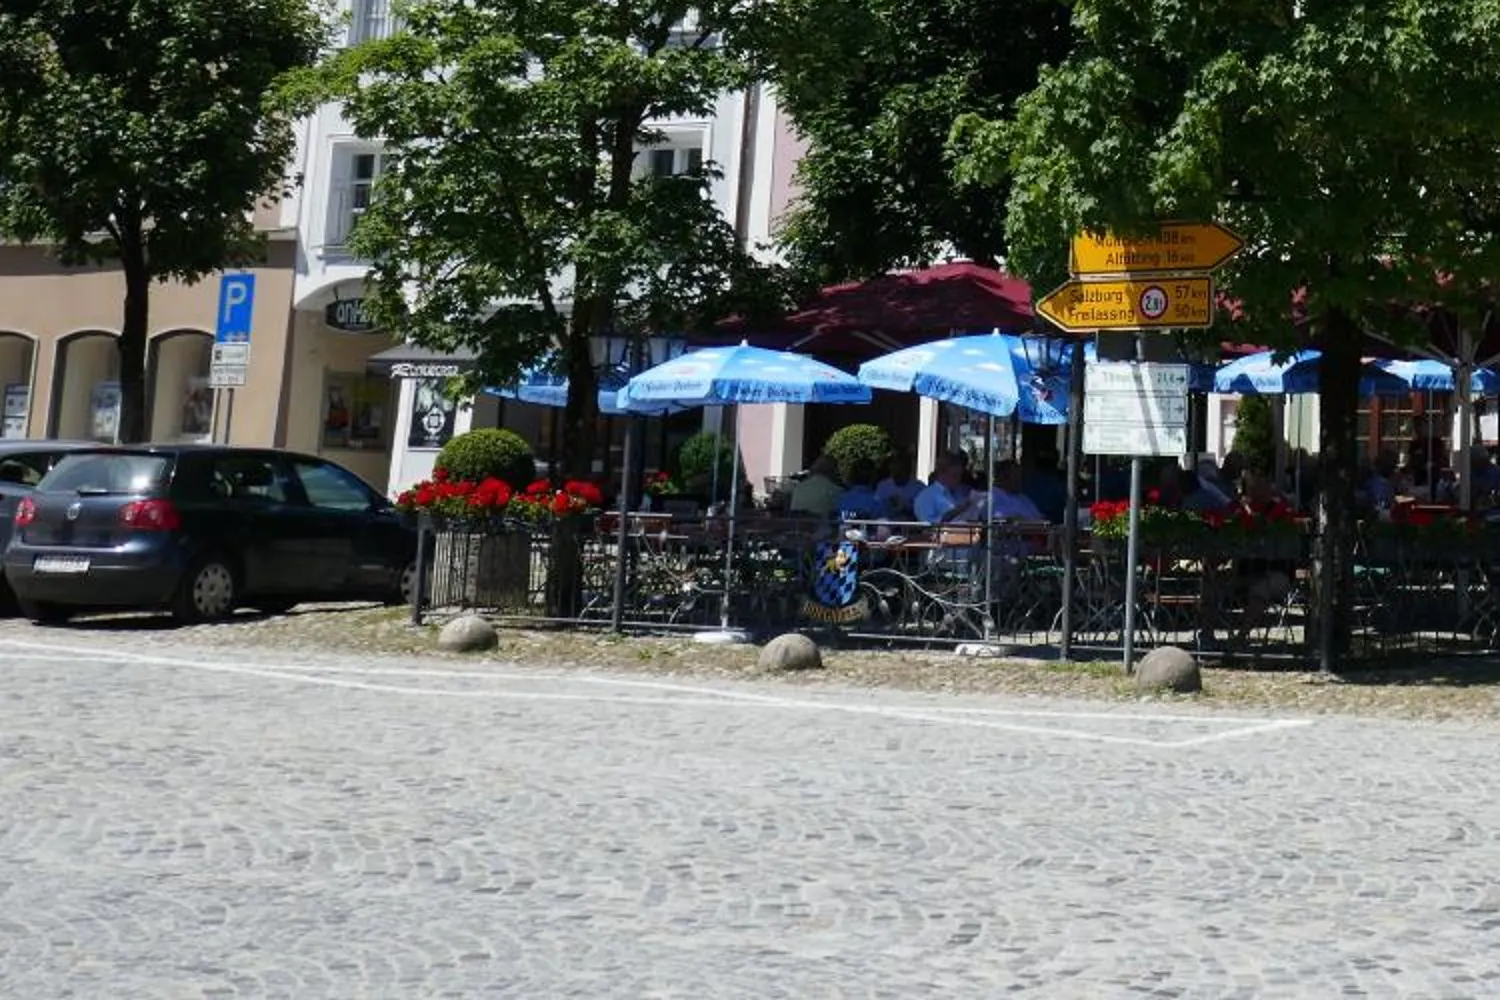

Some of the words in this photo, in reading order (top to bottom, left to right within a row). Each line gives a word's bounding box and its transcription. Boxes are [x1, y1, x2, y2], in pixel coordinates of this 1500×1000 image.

[224, 281, 247, 323] P
[1070, 289, 1124, 304] Salzburg
[1175, 285, 1190, 298] 57
[1191, 285, 1208, 298] km
[1069, 306, 1135, 321] Freilassing
[1191, 306, 1208, 318] km
